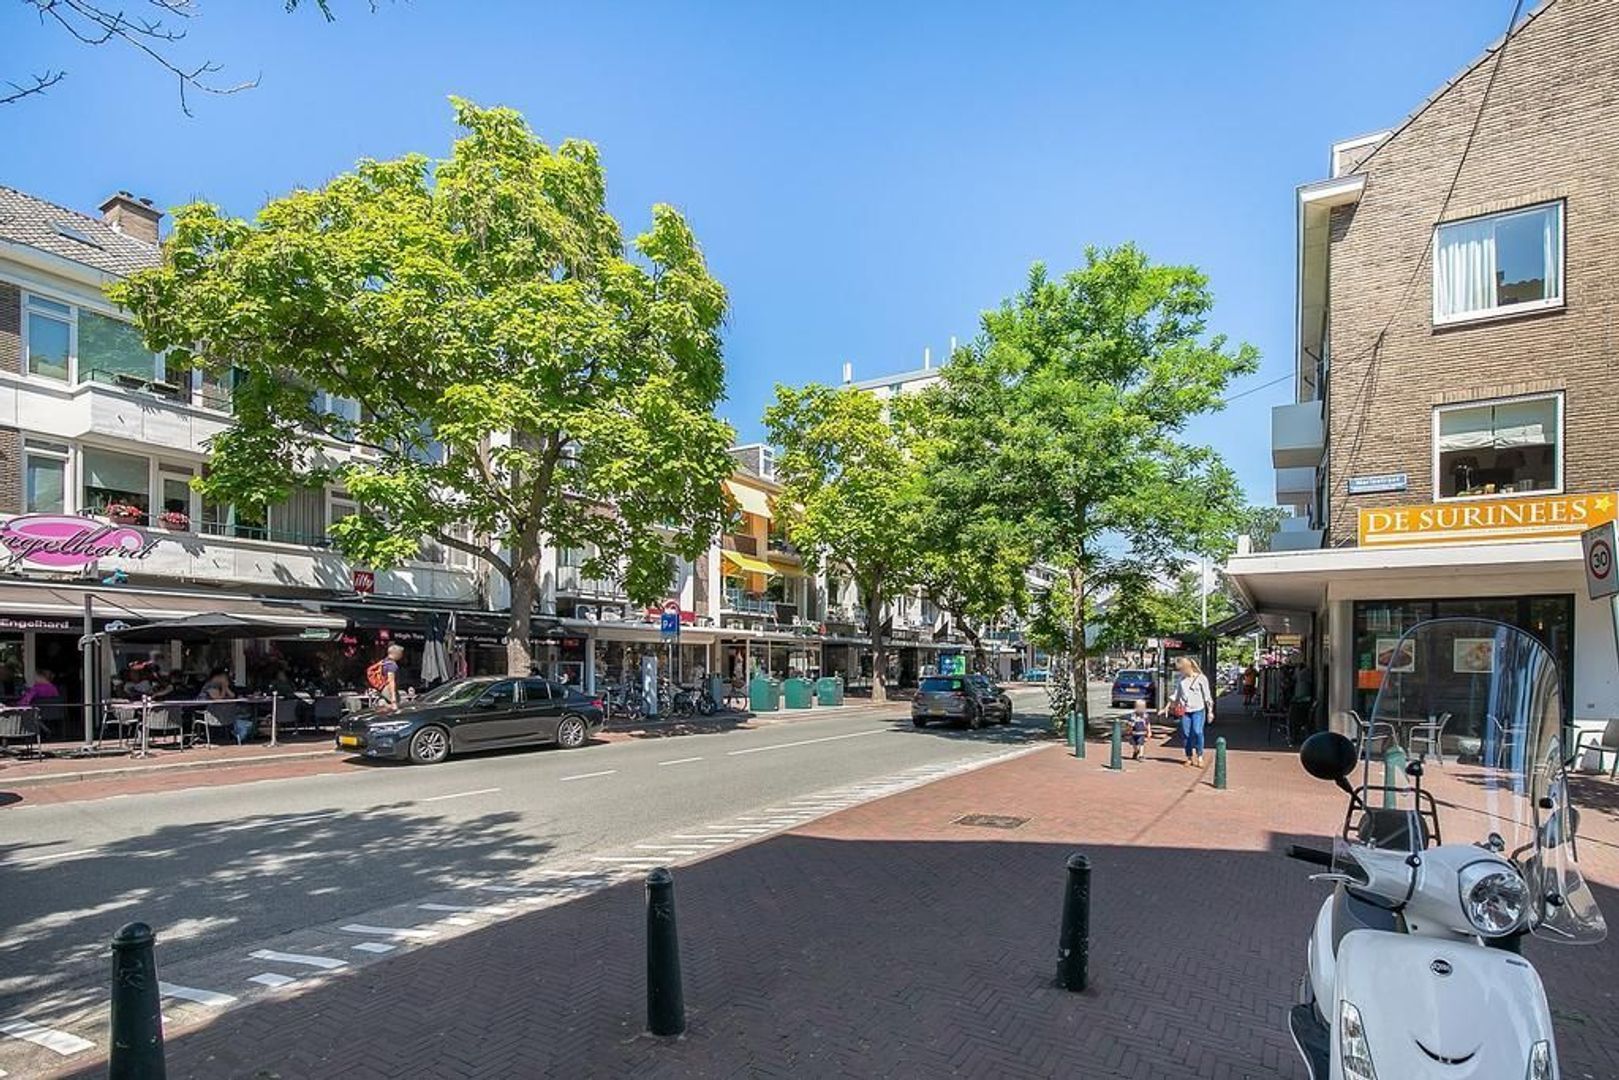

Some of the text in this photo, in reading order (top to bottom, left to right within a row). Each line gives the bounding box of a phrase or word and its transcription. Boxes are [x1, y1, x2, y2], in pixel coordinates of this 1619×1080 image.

[1367, 511, 1409, 533] DE
[1418, 499, 1588, 531] SURINEES
[1593, 551, 1608, 569] 30
[354, 574, 374, 589] illy
[0, 618, 70, 629] Engelhard
